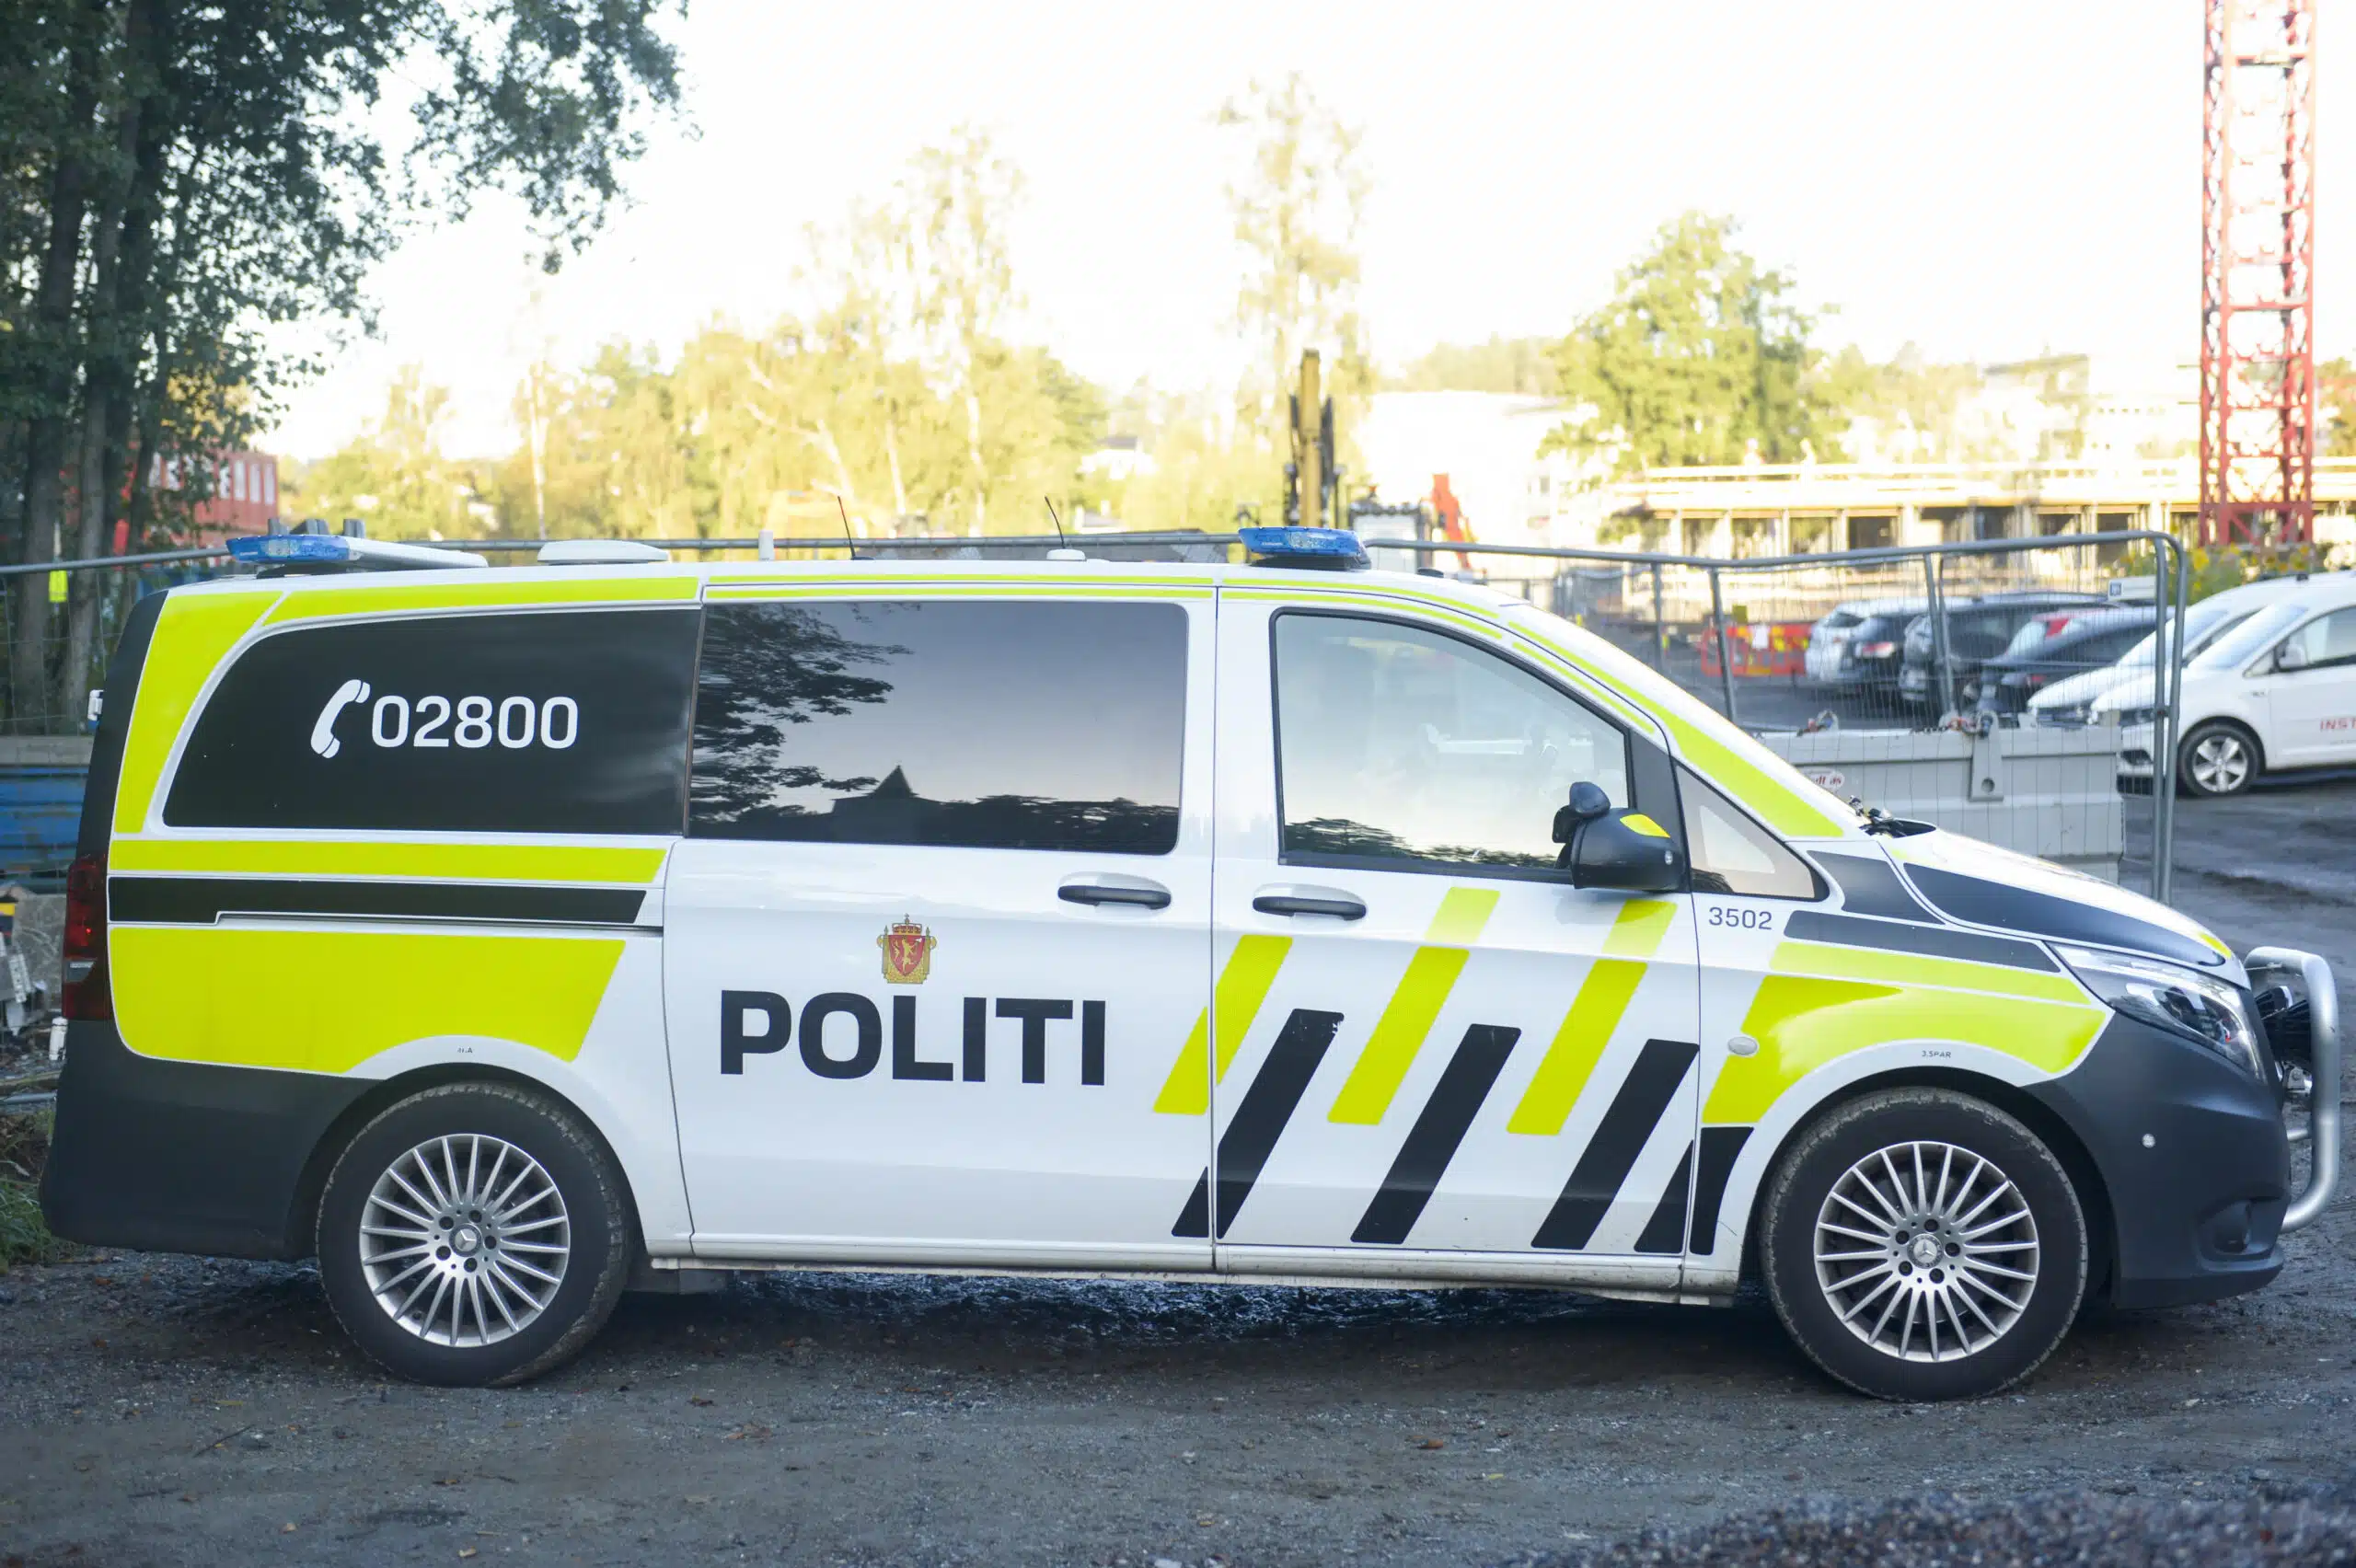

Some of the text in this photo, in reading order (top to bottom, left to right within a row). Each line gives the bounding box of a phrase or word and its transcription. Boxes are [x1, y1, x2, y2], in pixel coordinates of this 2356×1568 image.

[372, 695, 578, 749] 02800
[1708, 906, 1773, 930] 3502
[721, 989, 1105, 1086] POLITI
